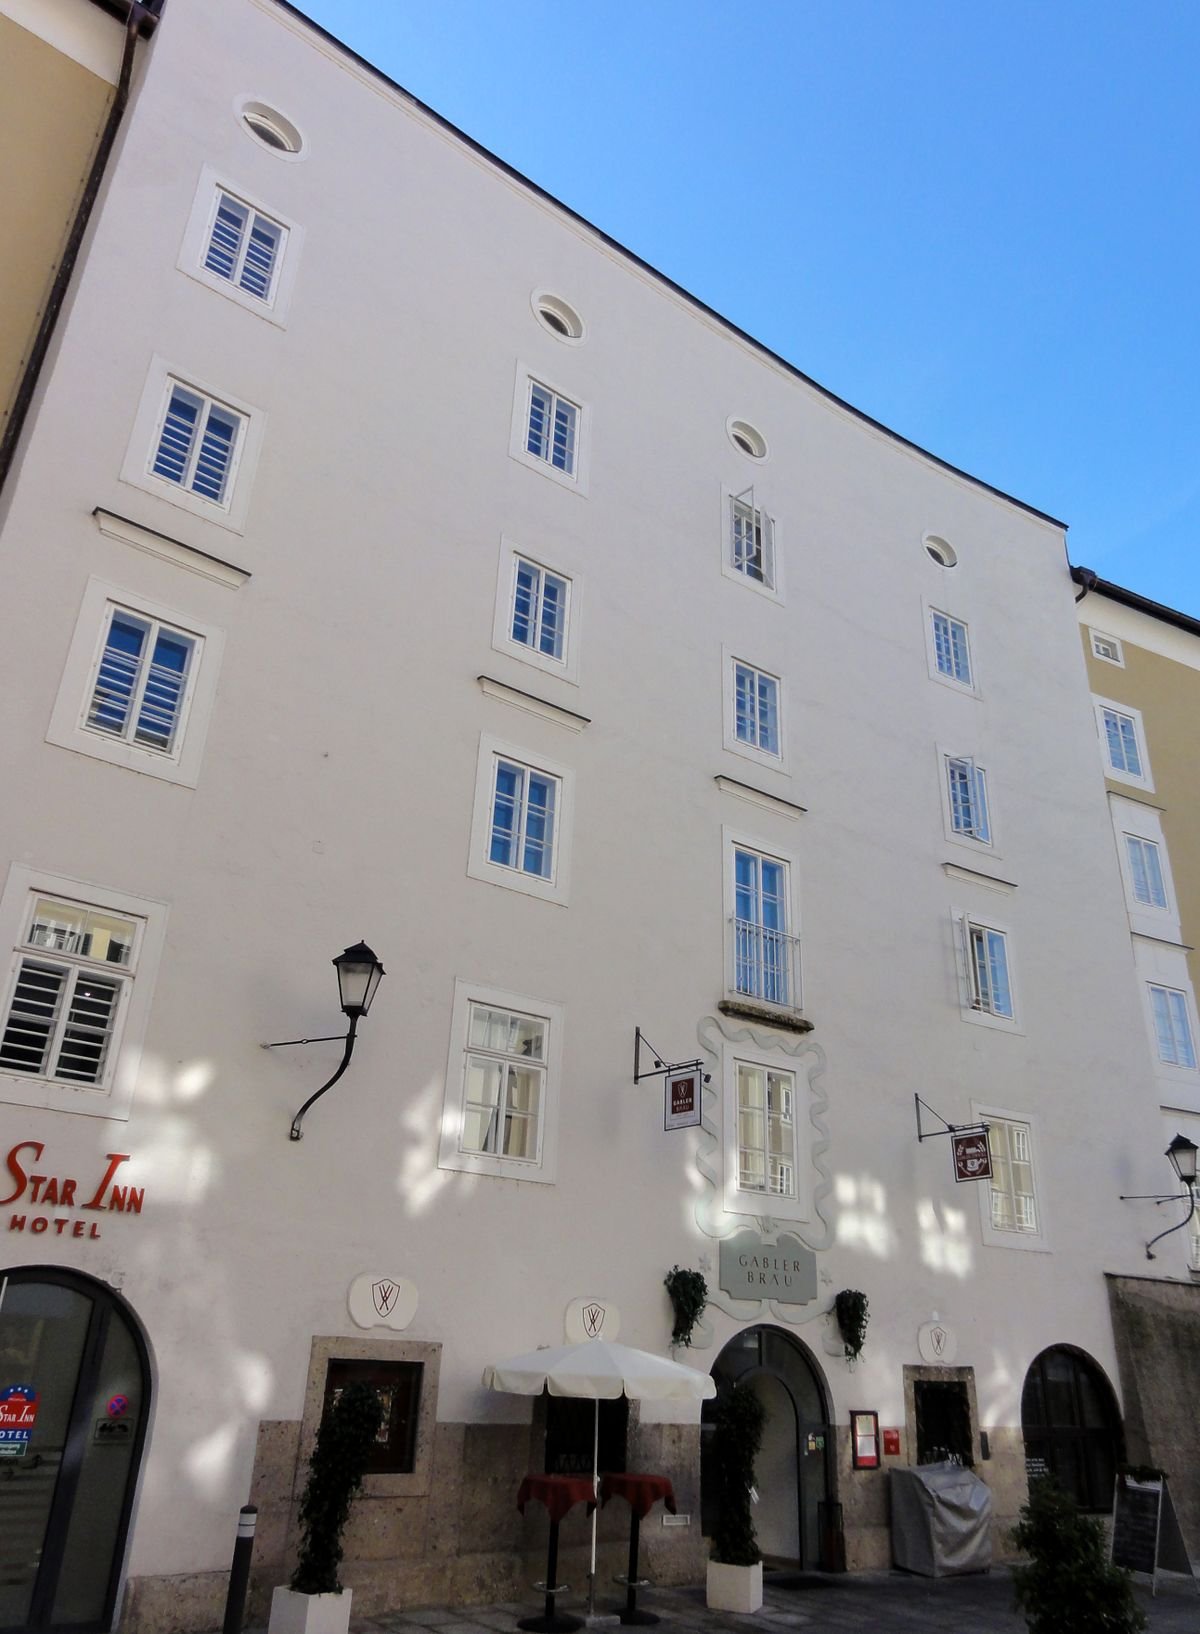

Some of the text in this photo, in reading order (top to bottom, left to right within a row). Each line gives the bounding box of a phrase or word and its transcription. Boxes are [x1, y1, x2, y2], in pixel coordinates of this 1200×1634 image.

[81, 1153, 146, 1214] INN
[9, 1214, 101, 1240] HOTEL
[738, 1254, 800, 1272] GABLER
[0, 1430, 28, 1439] OTEL
